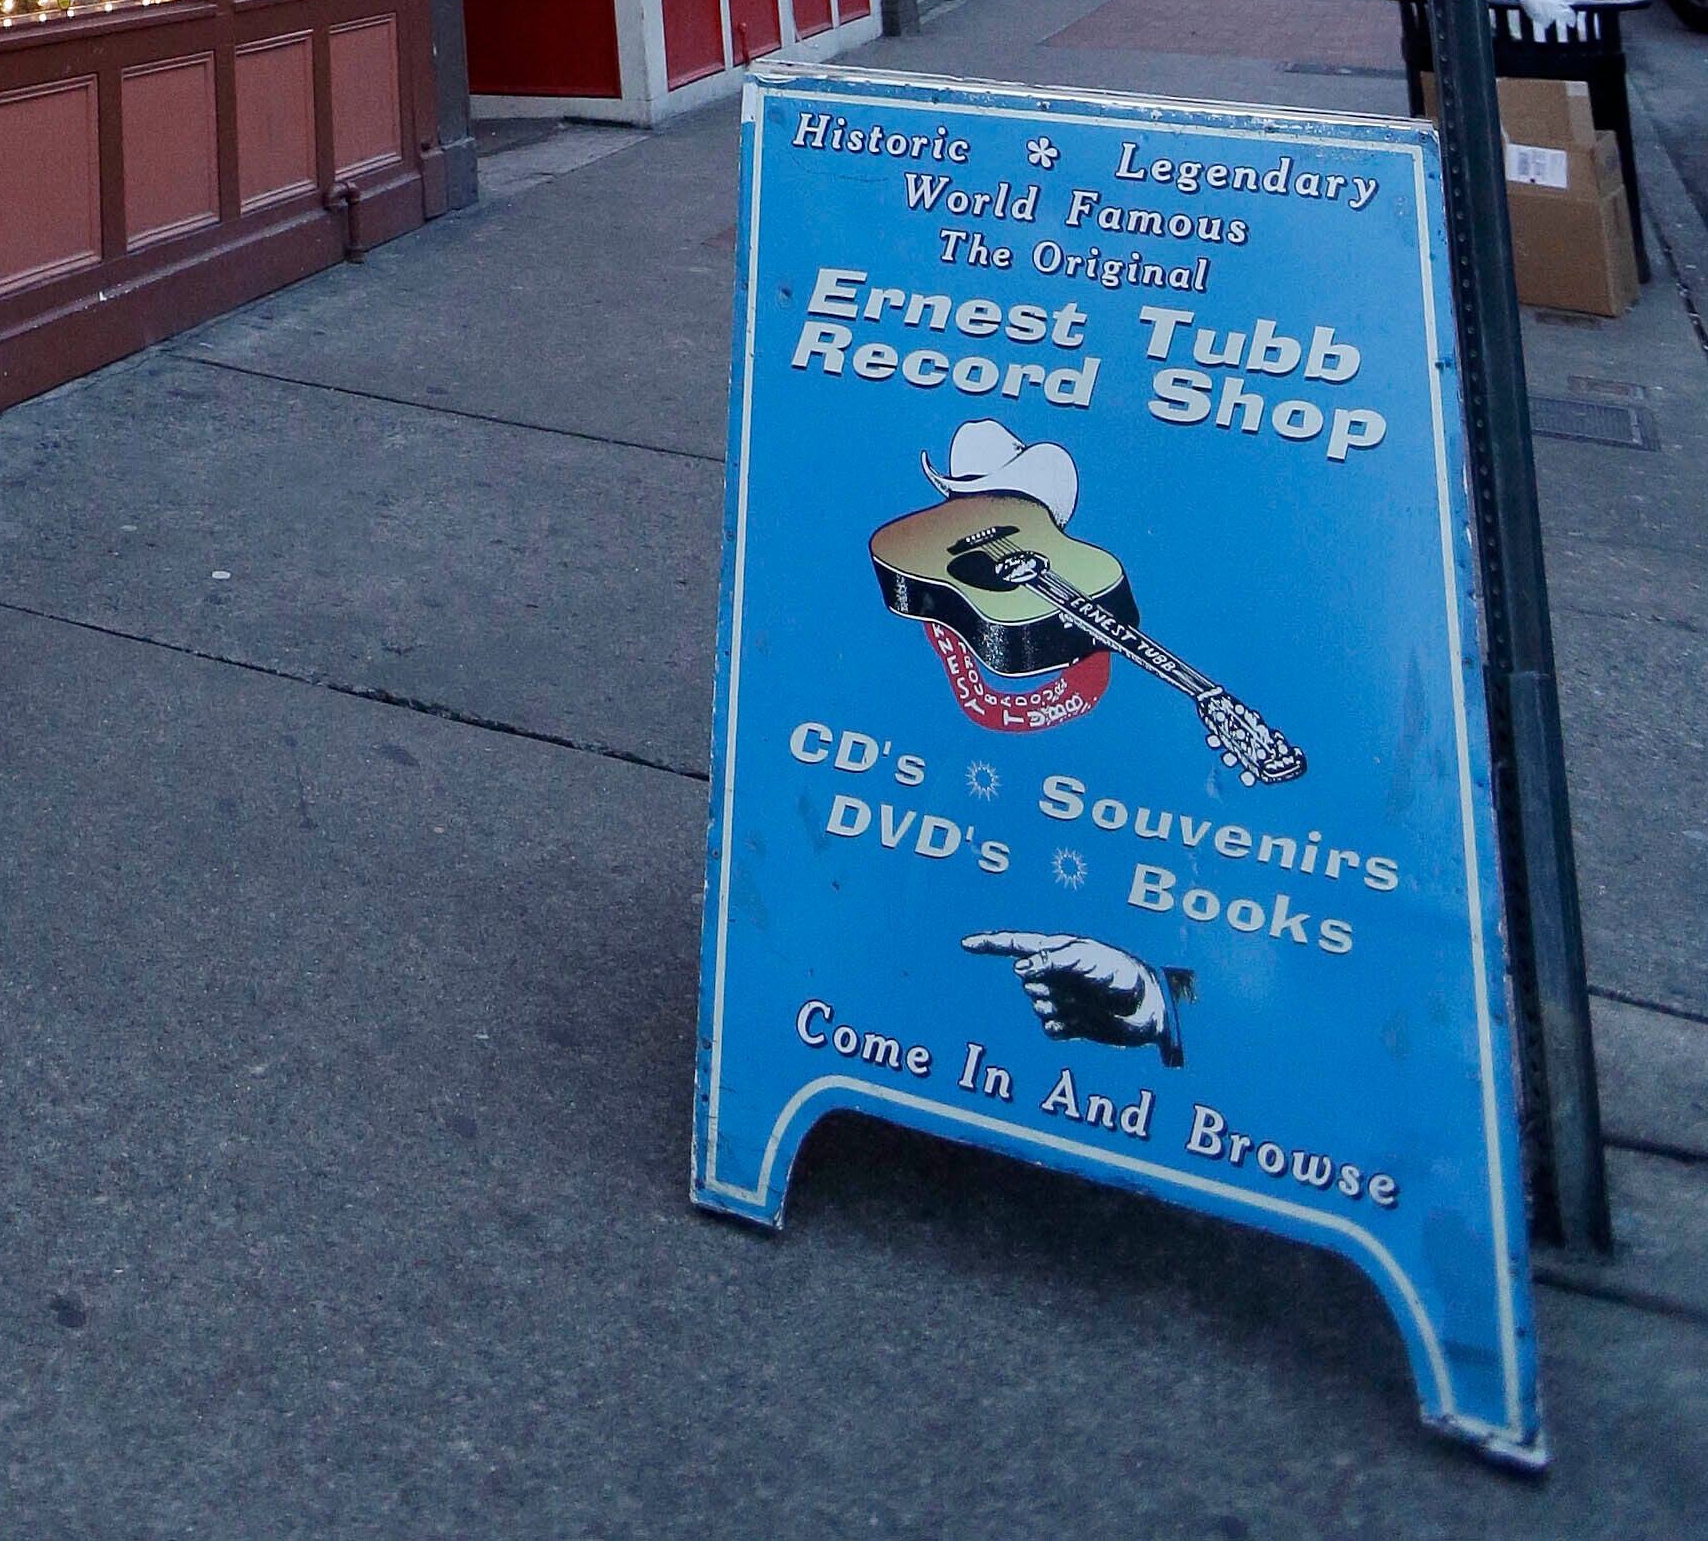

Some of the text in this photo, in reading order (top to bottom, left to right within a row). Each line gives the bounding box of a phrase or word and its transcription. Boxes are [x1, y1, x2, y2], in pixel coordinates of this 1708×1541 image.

[792, 113, 1380, 210] Historic Legendary
[904, 172, 1249, 245] World Famous
[939, 229, 1211, 294] The Original
[807, 266, 1362, 384] Ernest Tubb
[792, 320, 1388, 463] Record Shop
[1069, 596, 1177, 672] ERNEST TUBB
[790, 721, 1401, 893] CD's Souvenirs
[826, 793, 1355, 956] DVD's Books
[795, 999, 1401, 1210] Come In And Browse
